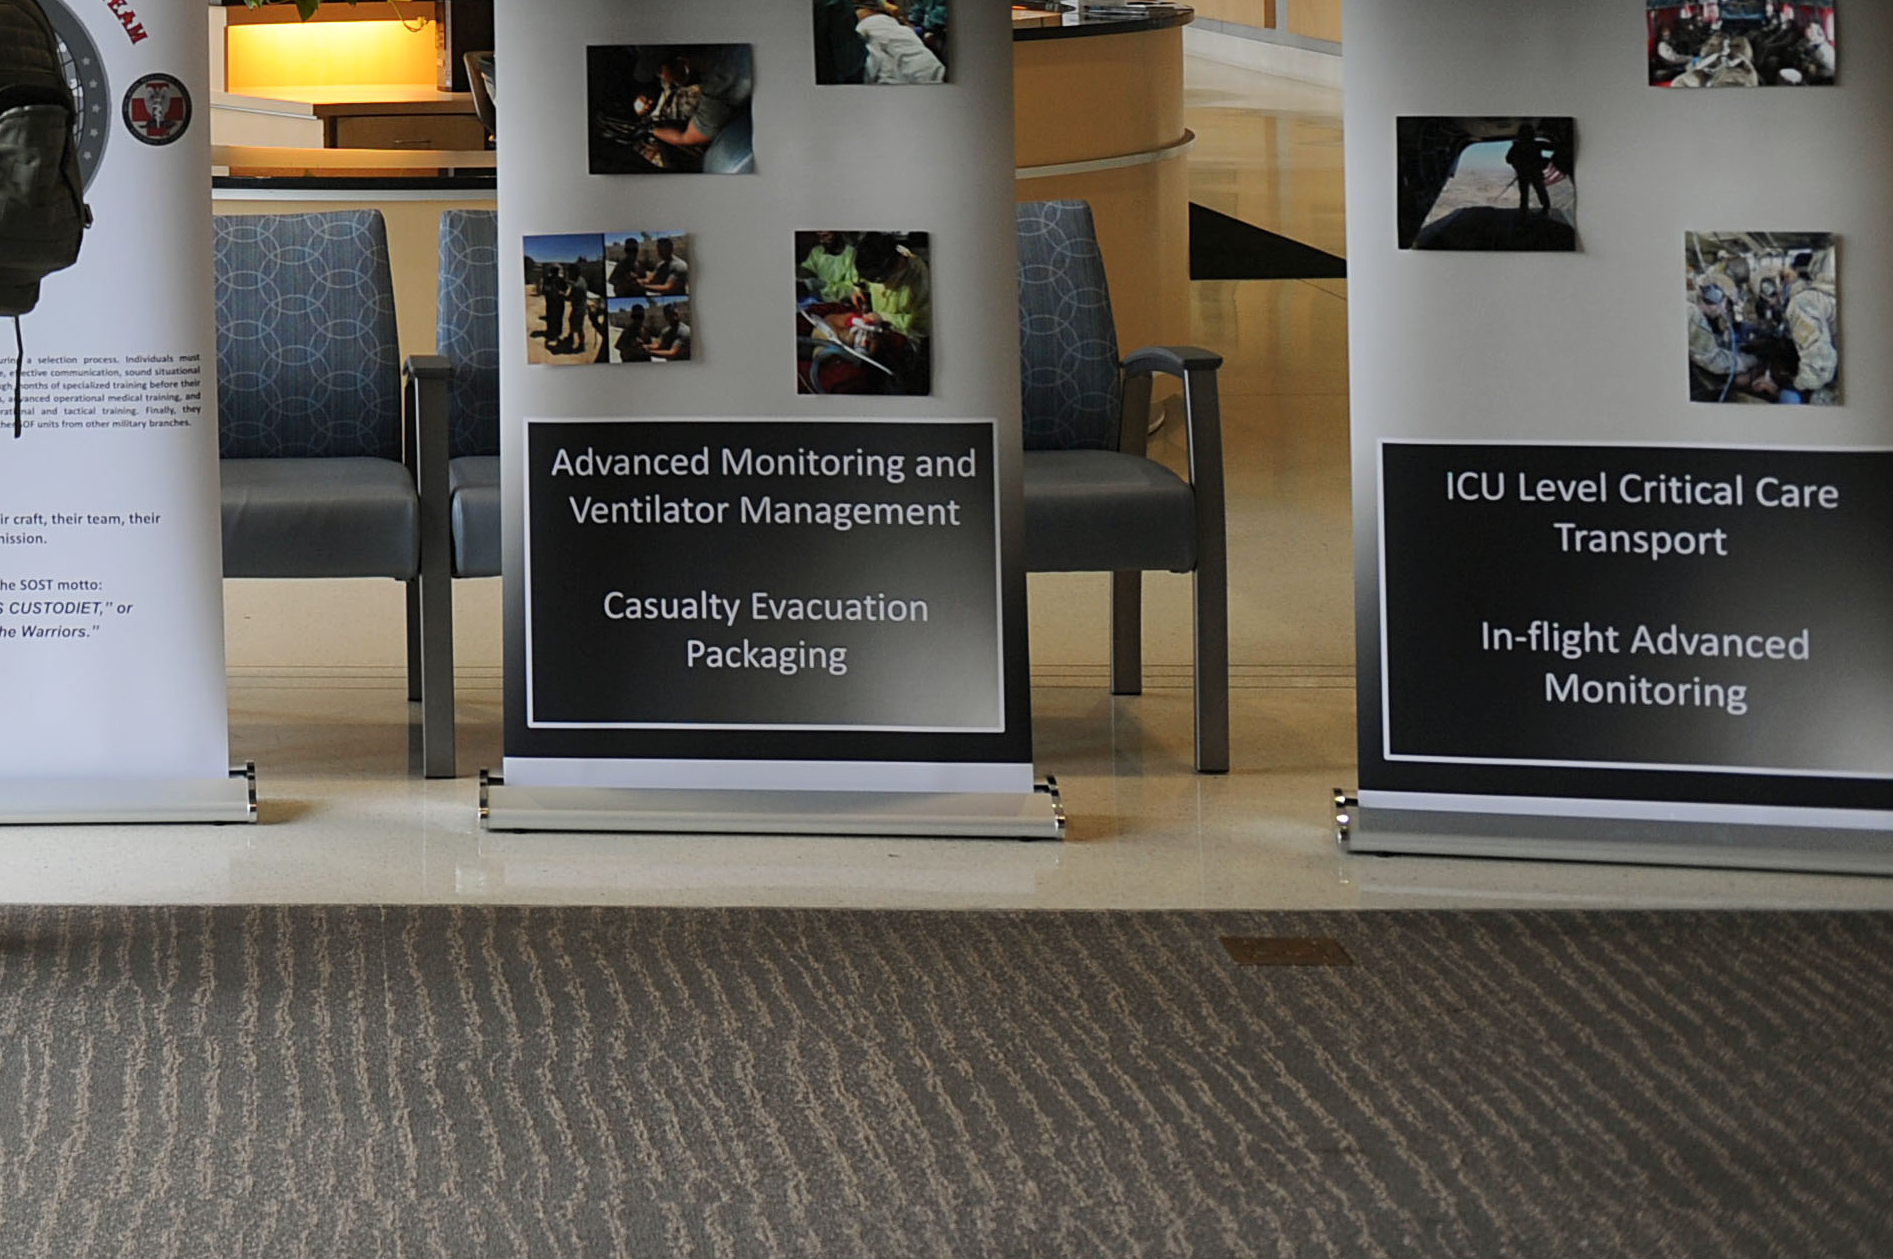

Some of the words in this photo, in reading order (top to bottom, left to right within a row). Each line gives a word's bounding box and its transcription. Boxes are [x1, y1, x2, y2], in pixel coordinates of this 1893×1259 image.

[38, 356, 78, 364] selection
[126, 354, 174, 363] Individuals
[179, 354, 200, 362] must
[551, 447, 709, 478] Advanced
[721, 448, 905, 484] Monitoring
[915, 449, 976, 479] and
[1447, 471, 1505, 502] ICU
[1519, 472, 1607, 503] Level
[1618, 473, 1744, 507] Critical
[1755, 478, 1840, 510] Care
[14, 512, 47, 528] craft,
[52, 512, 82, 525] their
[87, 514, 124, 527] team,
[129, 512, 161, 525] their
[569, 494, 730, 525] Ventilator
[740, 497, 962, 531] Management
[1554, 522, 1728, 561] Transport
[20, 579, 54, 591] SOST
[58, 580, 102, 591] motto:
[117, 604, 134, 614] or
[603, 591, 741, 626] Casualty
[752, 592, 929, 623] Evacuation
[686, 639, 849, 676] Packaging
[1482, 621, 1620, 660] In-flight
[1630, 624, 1810, 661] Advanced
[1545, 672, 1748, 715] Monitoring
